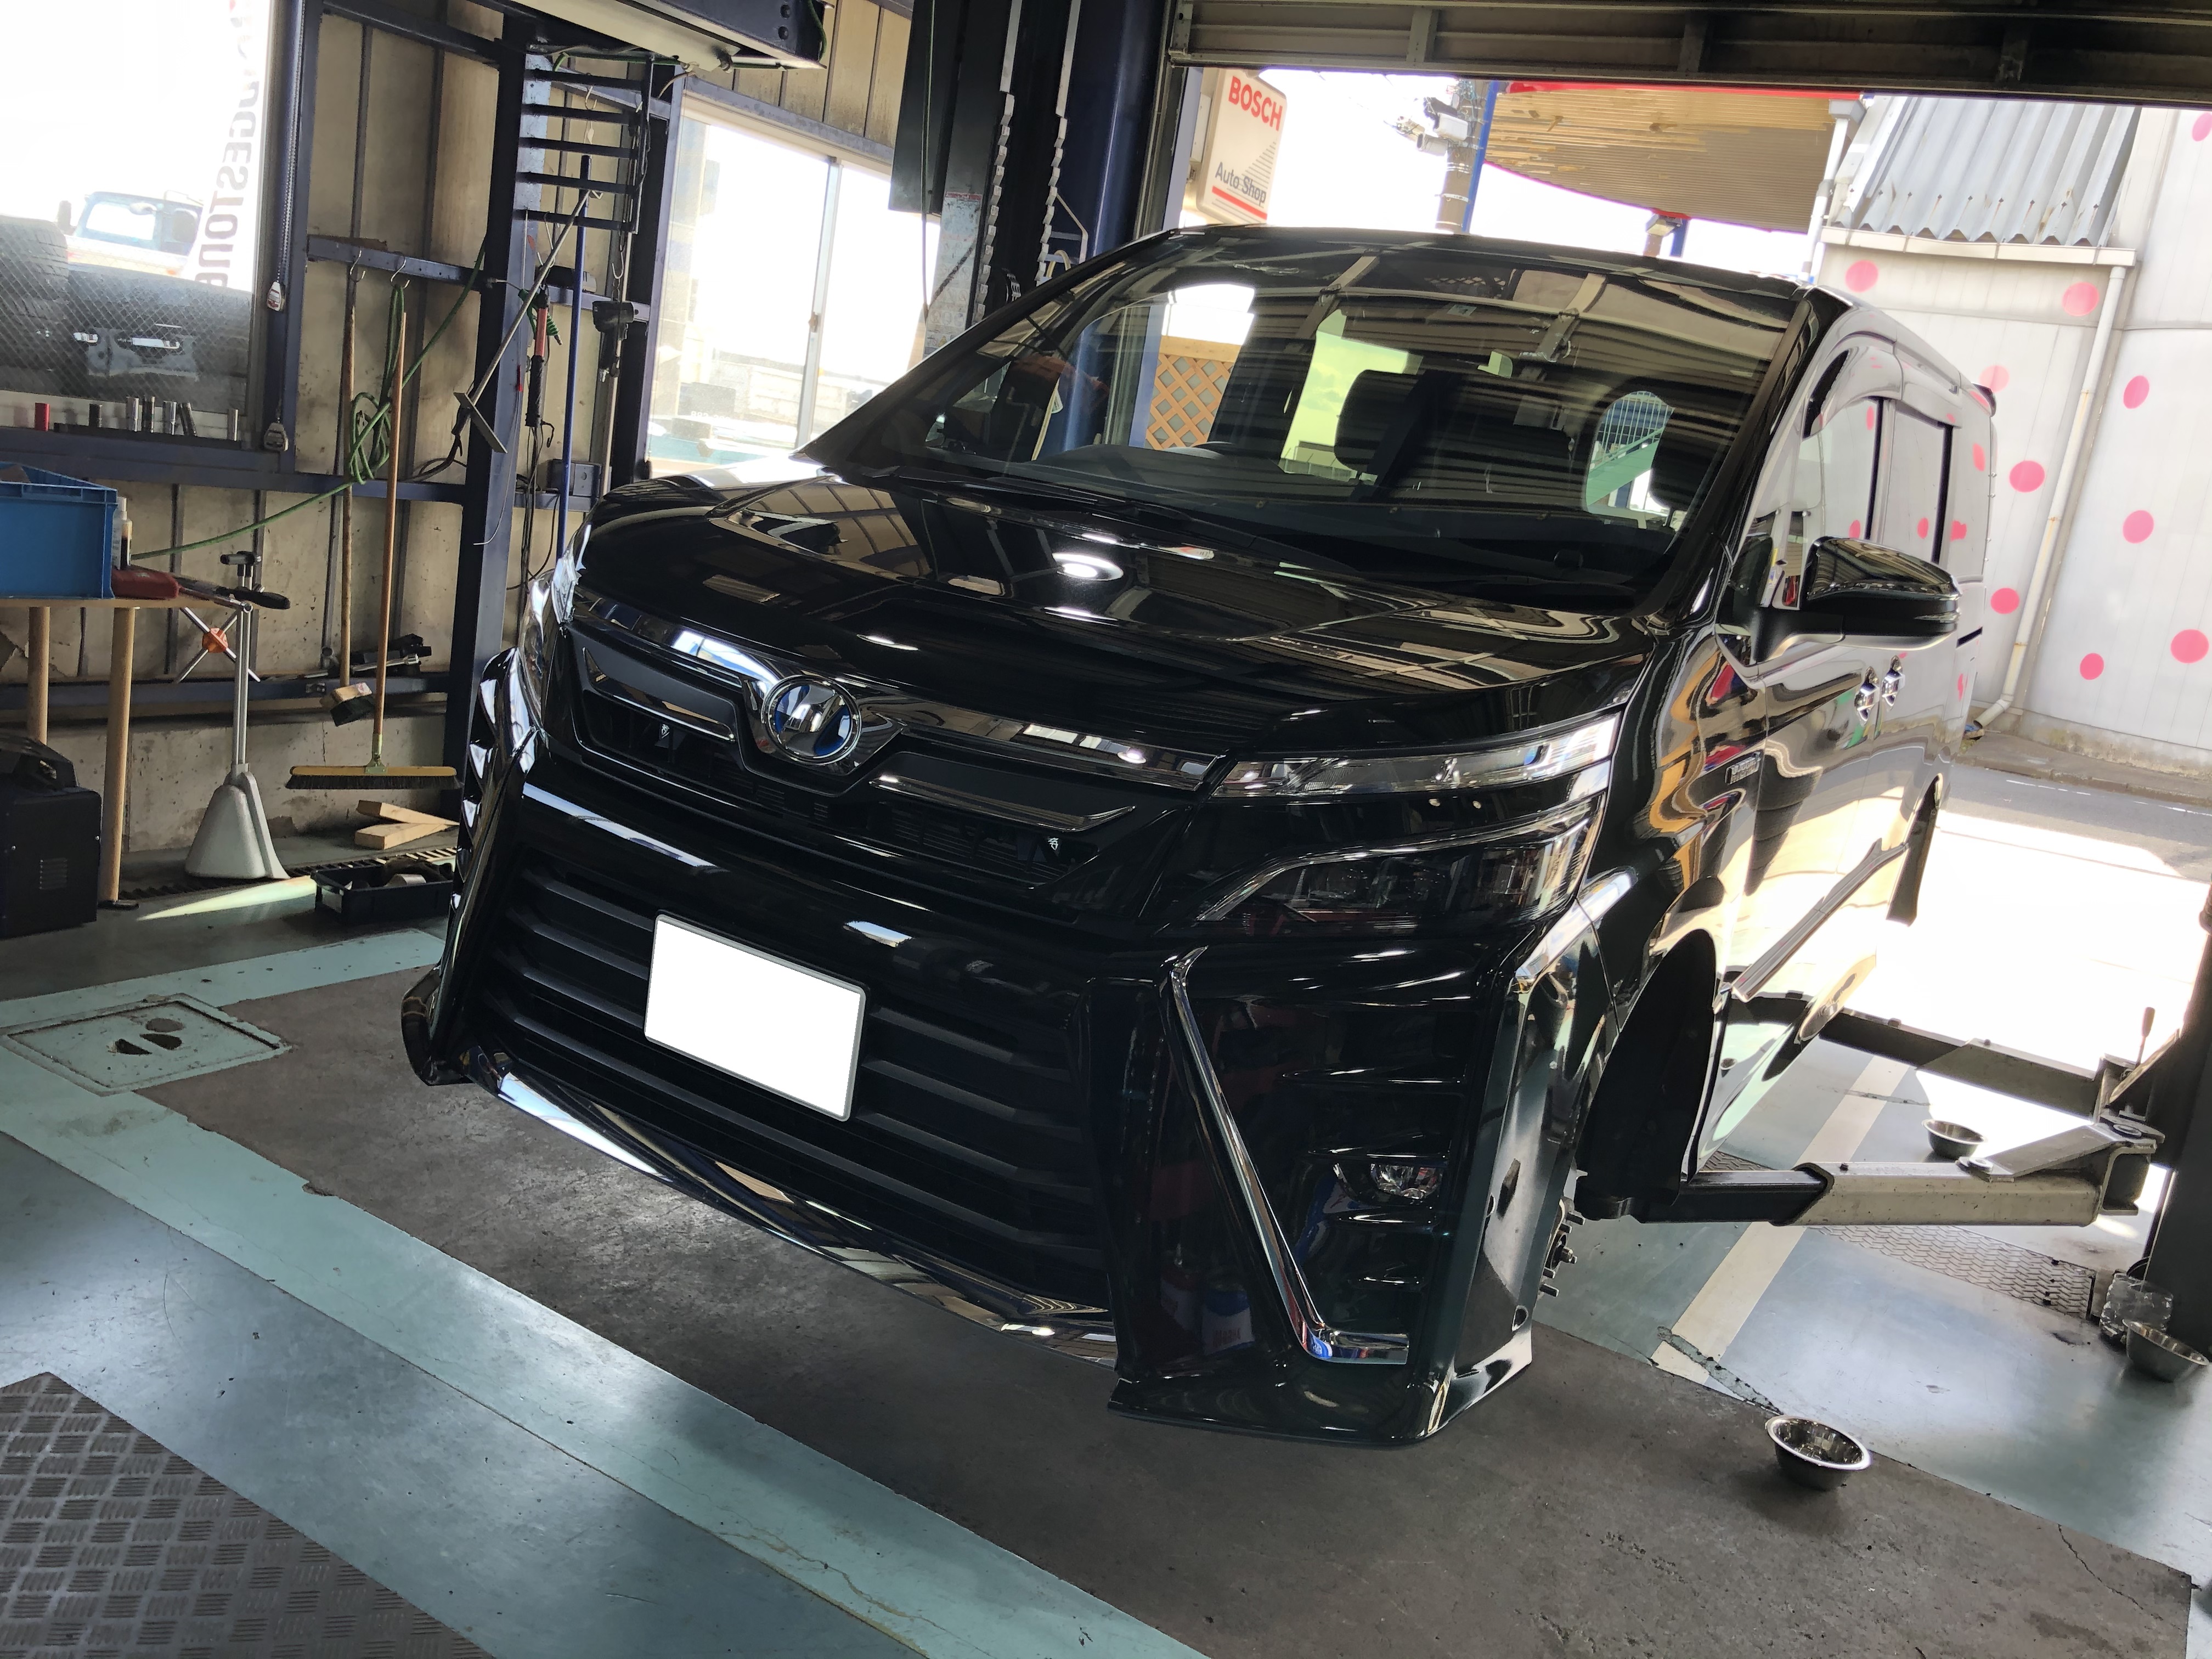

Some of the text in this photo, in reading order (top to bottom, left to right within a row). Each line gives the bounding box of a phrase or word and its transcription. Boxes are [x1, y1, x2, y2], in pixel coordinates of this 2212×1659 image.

[1228, 76, 1283, 131] BOSCH
[1215, 161, 1267, 206] Auto Shop
